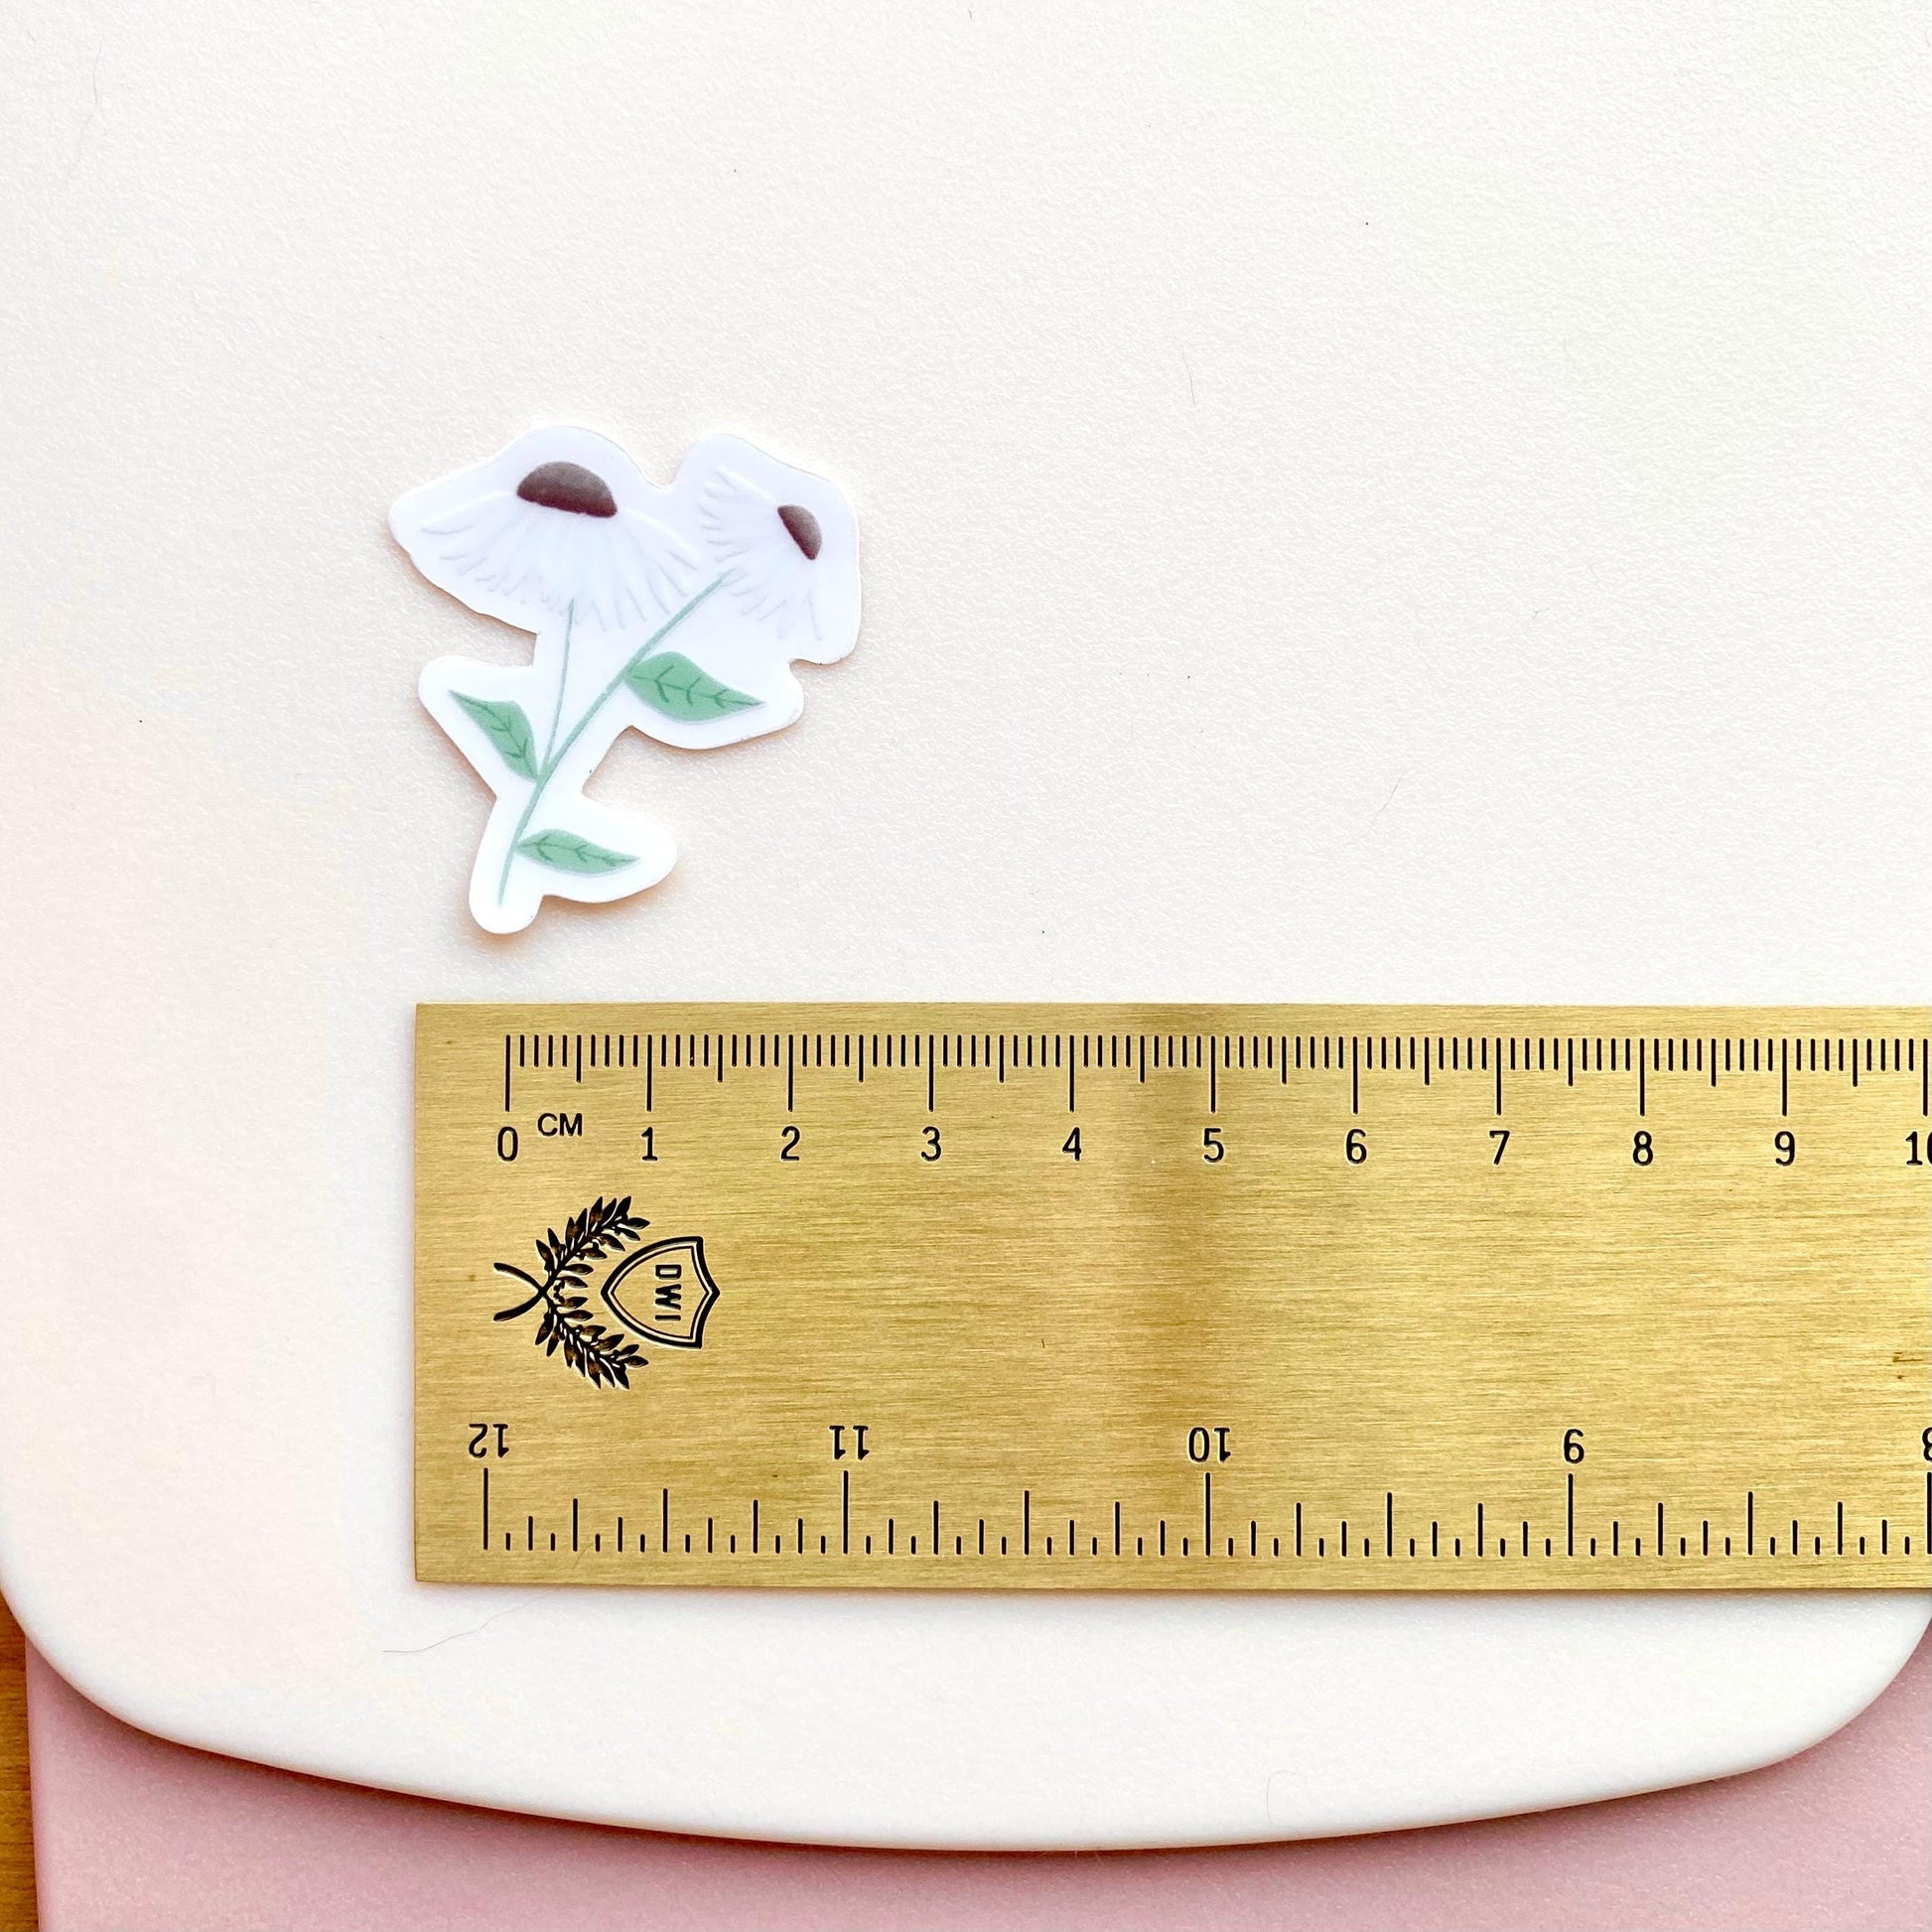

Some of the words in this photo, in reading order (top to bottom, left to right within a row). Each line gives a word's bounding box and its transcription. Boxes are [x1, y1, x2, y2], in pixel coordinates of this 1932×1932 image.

[537, 1112, 583, 1137] CM
[497, 1126, 518, 1162] 0
[640, 1126, 658, 1162] 1
[780, 1126, 800, 1162] 2
[920, 1126, 942, 1162] 3
[1061, 1127, 1082, 1162] 4
[1203, 1127, 1224, 1164] 5
[1345, 1128, 1367, 1165] 6
[1489, 1130, 1510, 1166] 7
[1632, 1130, 1654, 1167] 8
[1774, 1131, 1796, 1167] 9
[654, 1264, 682, 1321] DWI
[468, 1423, 509, 1458] 12
[829, 1425, 870, 1460] 11
[1188, 1427, 1231, 1462] 10
